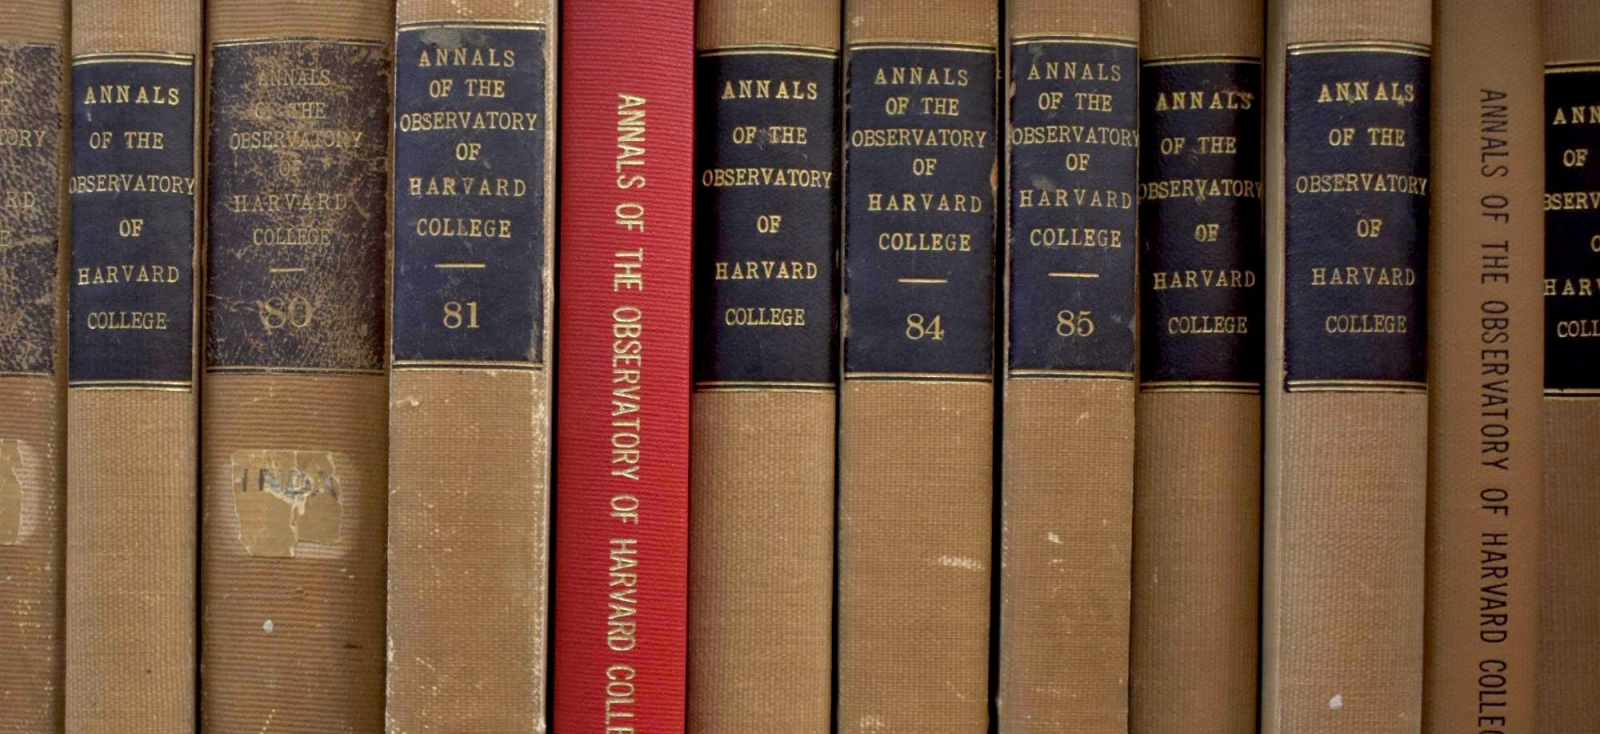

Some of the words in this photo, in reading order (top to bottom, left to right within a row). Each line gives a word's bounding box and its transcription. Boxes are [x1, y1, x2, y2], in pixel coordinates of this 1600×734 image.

[419, 48, 515, 67] ANNALS
[258, 69, 331, 86] ANNALS
[875, 67, 969, 87] ANNALS
[1028, 62, 1121, 82] ANNALS
[84, 85, 180, 105] ANNALS
[429, 80, 453, 98] OF
[465, 80, 505, 98] THE
[722, 80, 817, 100] ANNALS
[1318, 82, 1415, 104] ANNALS
[290, 102, 326, 119] THE
[886, 98, 908, 115] OF
[922, 98, 959, 116] THE
[1038, 92, 1063, 111] OF
[1075, 92, 1113, 112] THE
[1155, 91, 1252, 111] ANNALS
[400, 112, 537, 132] OBSERVATORY
[90, 132, 112, 150] OF
[124, 131, 164, 149] THE
[230, 131, 363, 150] OBSERVATORY
[615, 92, 646, 189] ANNALS
[733, 127, 756, 144] OF
[769, 126, 807, 144] THE
[852, 129, 986, 148] OBSERVATORY
[1012, 125, 1139, 147] OBSERVATORY
[1329, 129, 1355, 147] OF
[1368, 128, 1406, 147] THE
[1480, 88, 1509, 178] ANNALS
[456, 143, 481, 161] OF
[1160, 138, 1184, 155] OF
[1198, 136, 1237, 154] THE
[913, 159, 937, 176] OF
[1066, 154, 1089, 171] OF
[1563, 149, 1588, 167] OF
[69, 175, 195, 196] OBSERVATORY
[409, 177, 527, 197] HARVARD
[702, 168, 832, 189] OBSERVATORY
[1295, 174, 1427, 196] OBSERVATORY
[1019, 189, 1132, 210] HARVARD
[1139, 179, 1262, 200] OBSERVATORY
[234, 194, 346, 213] HARVARD
[868, 194, 982, 213] HARVARD
[1480, 194, 1509, 225] OF
[119, 219, 144, 237] OF
[615, 203, 645, 233] OF
[757, 215, 781, 233] OF
[253, 229, 331, 246] COLLEGE
[417, 219, 512, 238] COLLEGE
[1030, 228, 1121, 248] COLLEGE
[1194, 224, 1219, 242] OF
[1356, 220, 1382, 238] OF
[879, 233, 971, 252] COLLEGE
[614, 248, 644, 292] THE
[716, 262, 817, 280] HARVARD
[1481, 240, 1509, 284] THE
[78, 265, 180, 286] HARVARD
[1153, 270, 1255, 290] HARVARD
[1312, 267, 1415, 287] HARVARD
[87, 312, 167, 330] COLLEGE
[263, 297, 313, 329] 80
[443, 301, 480, 329] 81
[725, 308, 805, 326] COLLEGE
[906, 314, 945, 340] 84
[1056, 310, 1094, 337] 85
[1168, 316, 1248, 335] COLLEGE
[1326, 315, 1407, 333] COLLEGE
[610, 306, 642, 481] OBSERVATORY
[1480, 300, 1509, 470] OBSERVATORY
[609, 495, 639, 525] OF
[1480, 488, 1508, 516] OF
[606, 538, 638, 652] HARVARD
[1480, 533, 1508, 644] HARVARD
